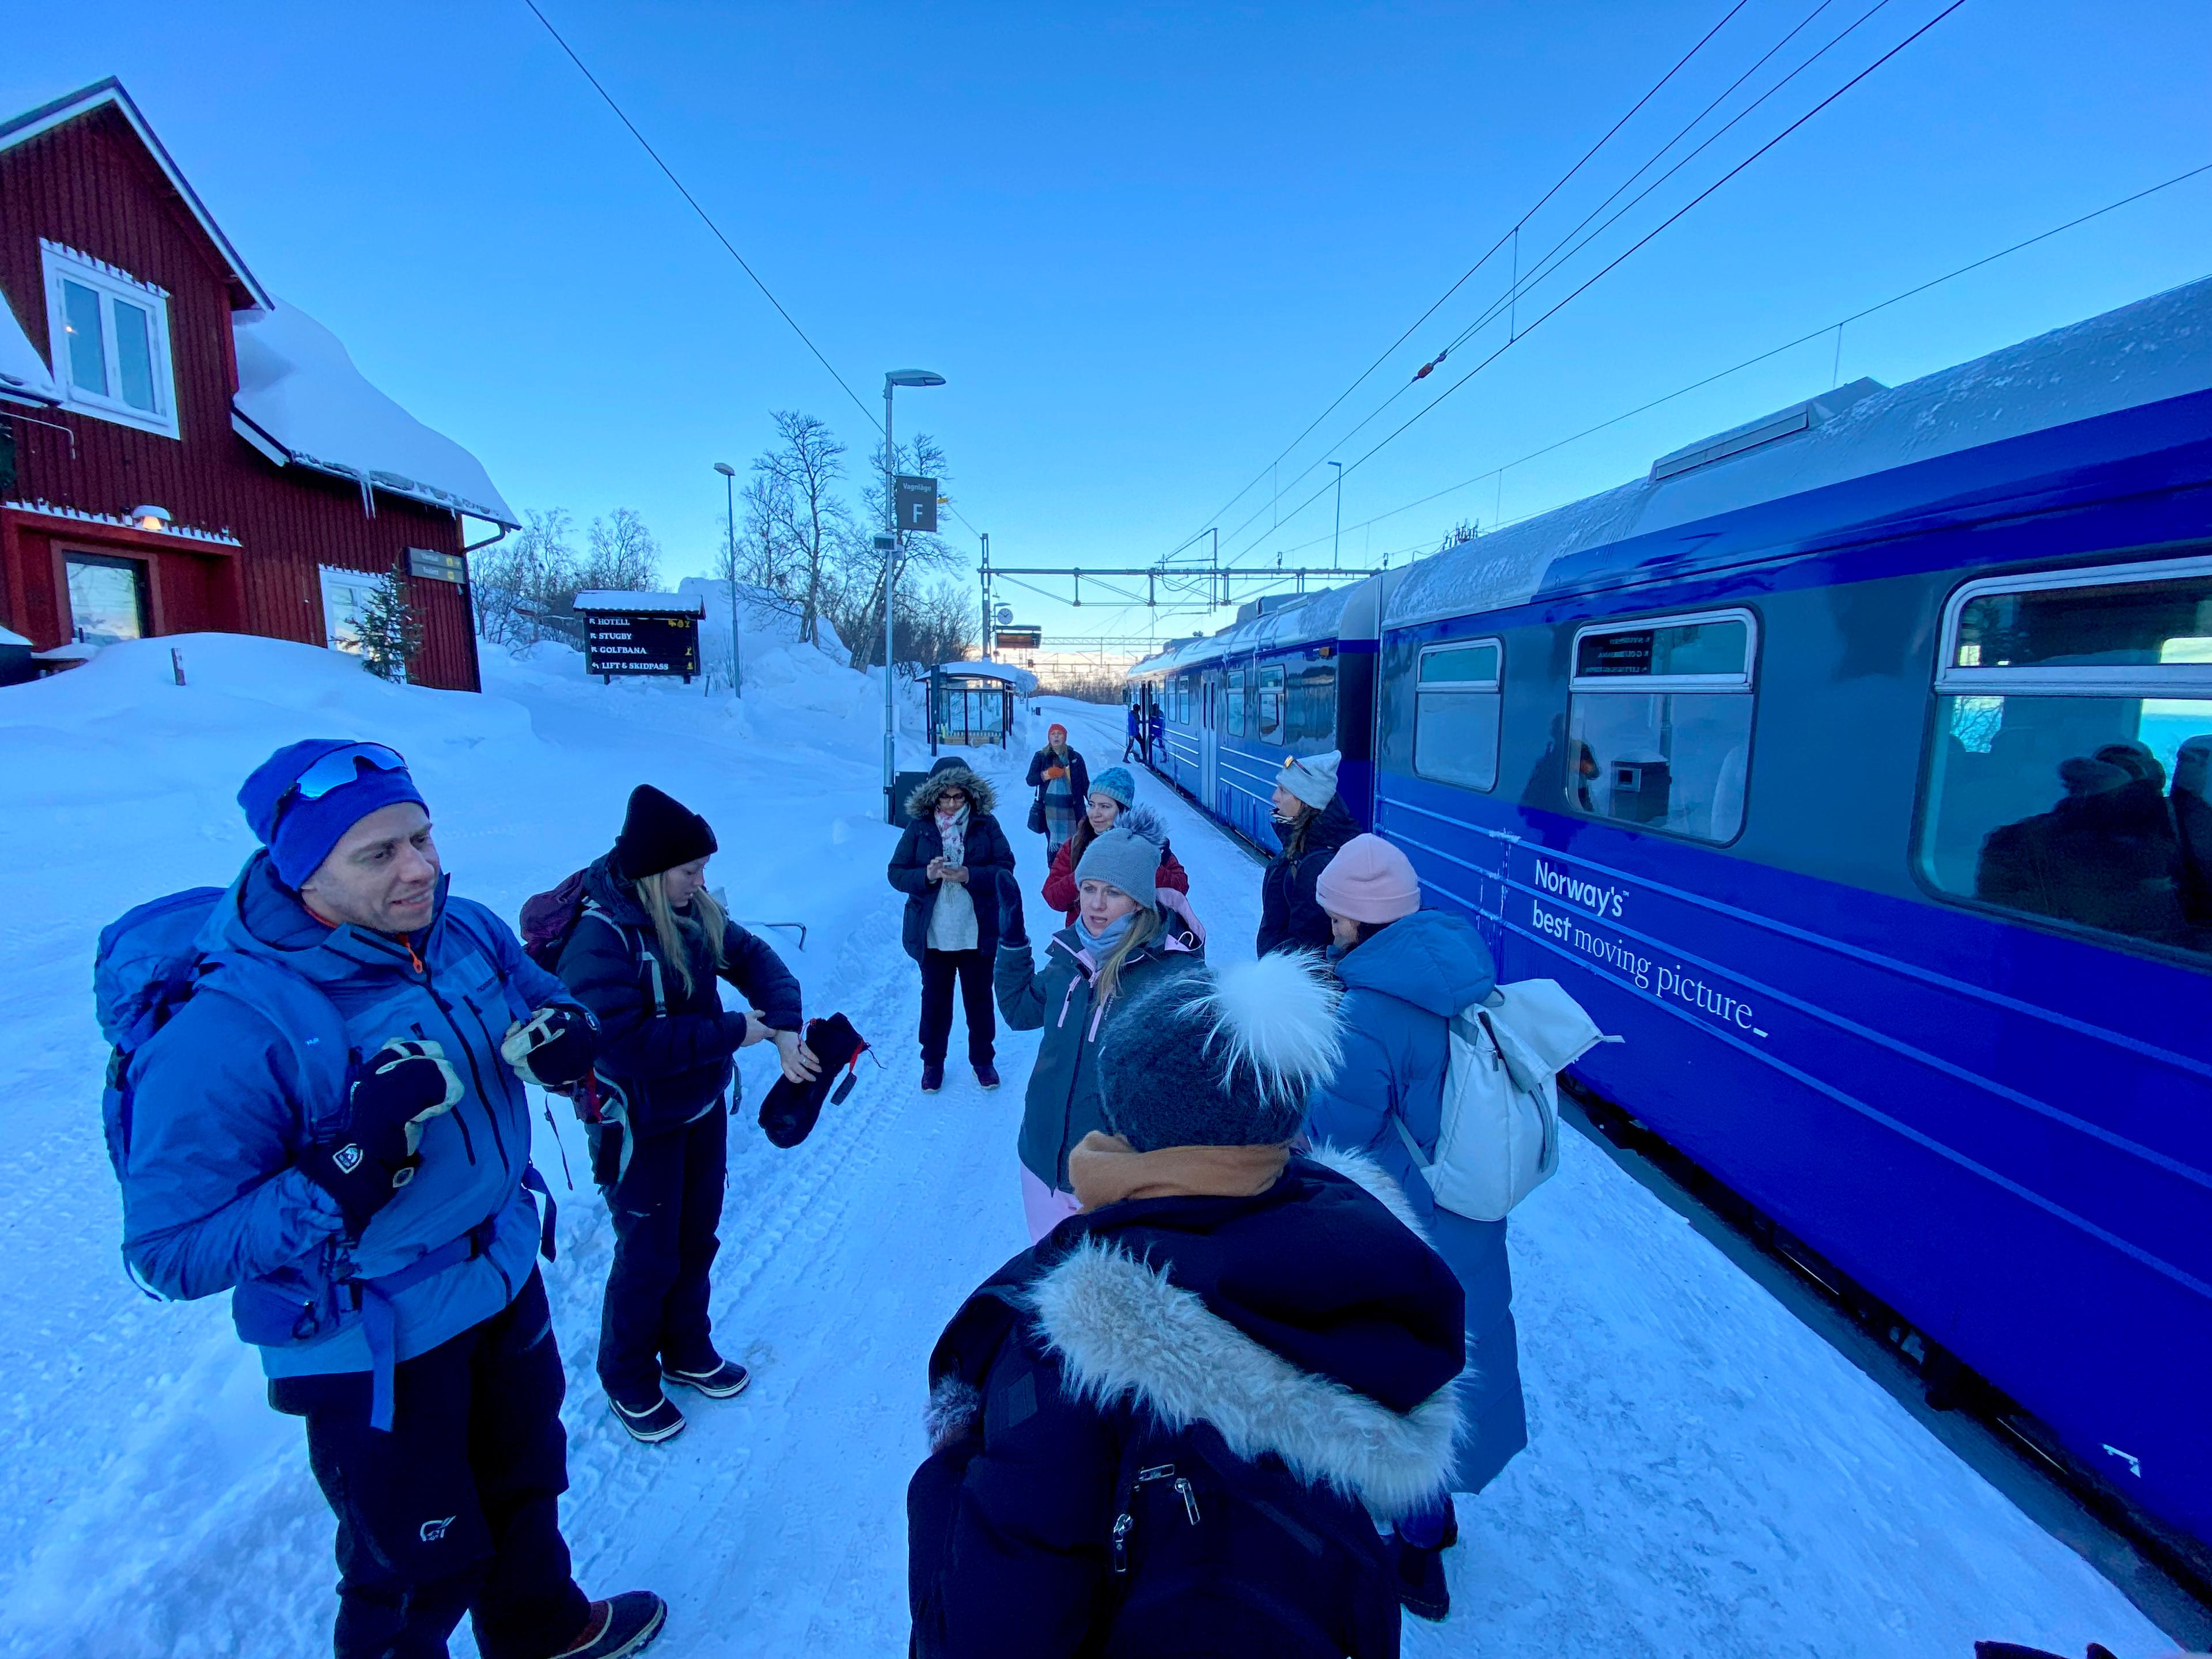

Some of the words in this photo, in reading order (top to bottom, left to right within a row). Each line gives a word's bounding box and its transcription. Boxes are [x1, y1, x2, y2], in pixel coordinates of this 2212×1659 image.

[903, 483, 931, 492] Vagnläge
[912, 503, 923, 523] F
[600, 646, 647, 654] GOLFBANA
[629, 662, 669, 671] SKIDPASS
[1533, 899, 1571, 941] best
[1574, 929, 1652, 988] moving
